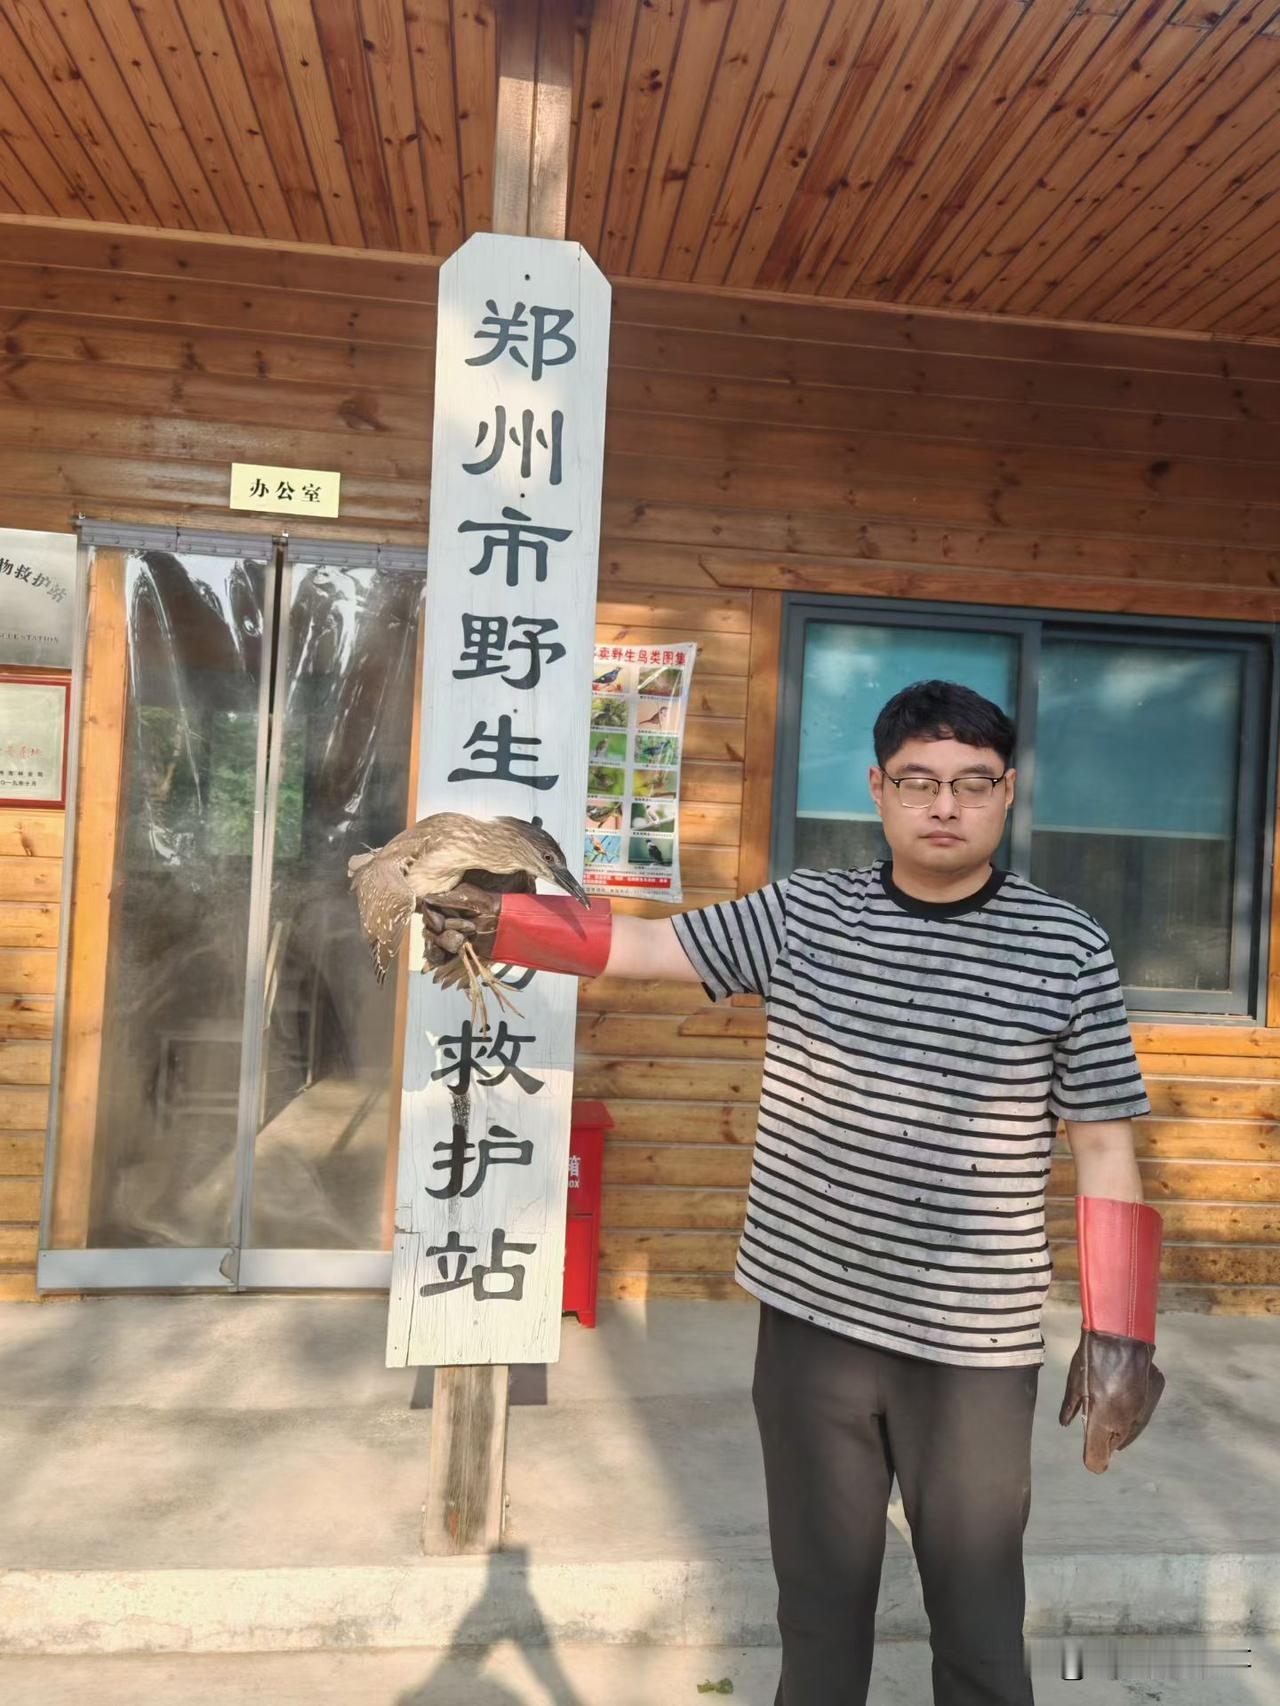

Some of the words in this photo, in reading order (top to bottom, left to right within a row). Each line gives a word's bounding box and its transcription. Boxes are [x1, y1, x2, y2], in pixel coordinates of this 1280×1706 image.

[249, 478, 321, 503] 办公室
[593, 647, 686, 665] 卖野生鸟类图集
[420, 299, 578, 1302] 郑州市野生救护站
[569, 1179, 580, 1188] OX
